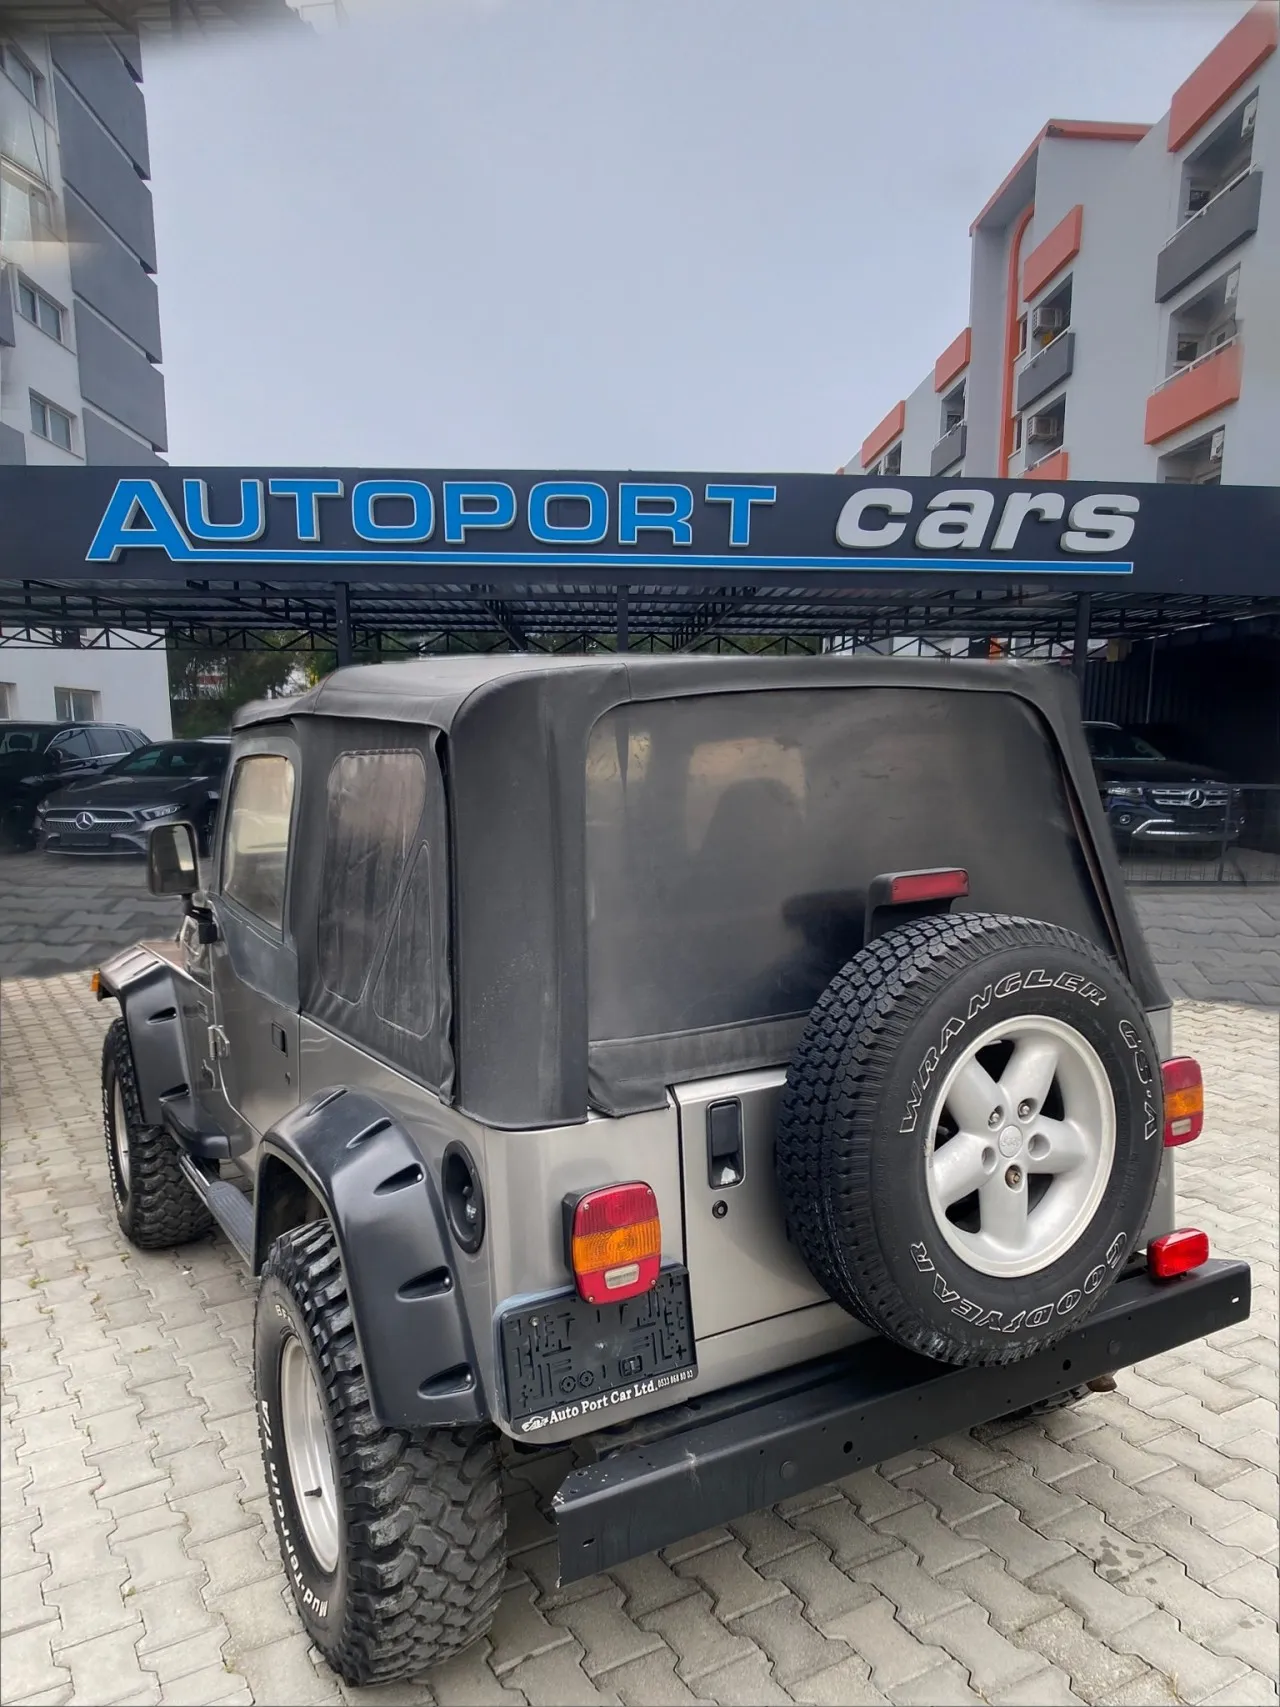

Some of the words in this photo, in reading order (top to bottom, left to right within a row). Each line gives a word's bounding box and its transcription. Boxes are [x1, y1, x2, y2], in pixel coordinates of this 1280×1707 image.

[85, 478, 778, 564] AUTOPORT
[834, 487, 1141, 553] cars
[899, 968, 1108, 1134] WRANGLER
[909, 1231, 1129, 1334] GOODYEAR
[549, 1405, 580, 1424] Auto
[581, 1395, 609, 1414] Port
[610, 1388, 633, 1404] Car
[633, 1379, 659, 1398] Ltd.
